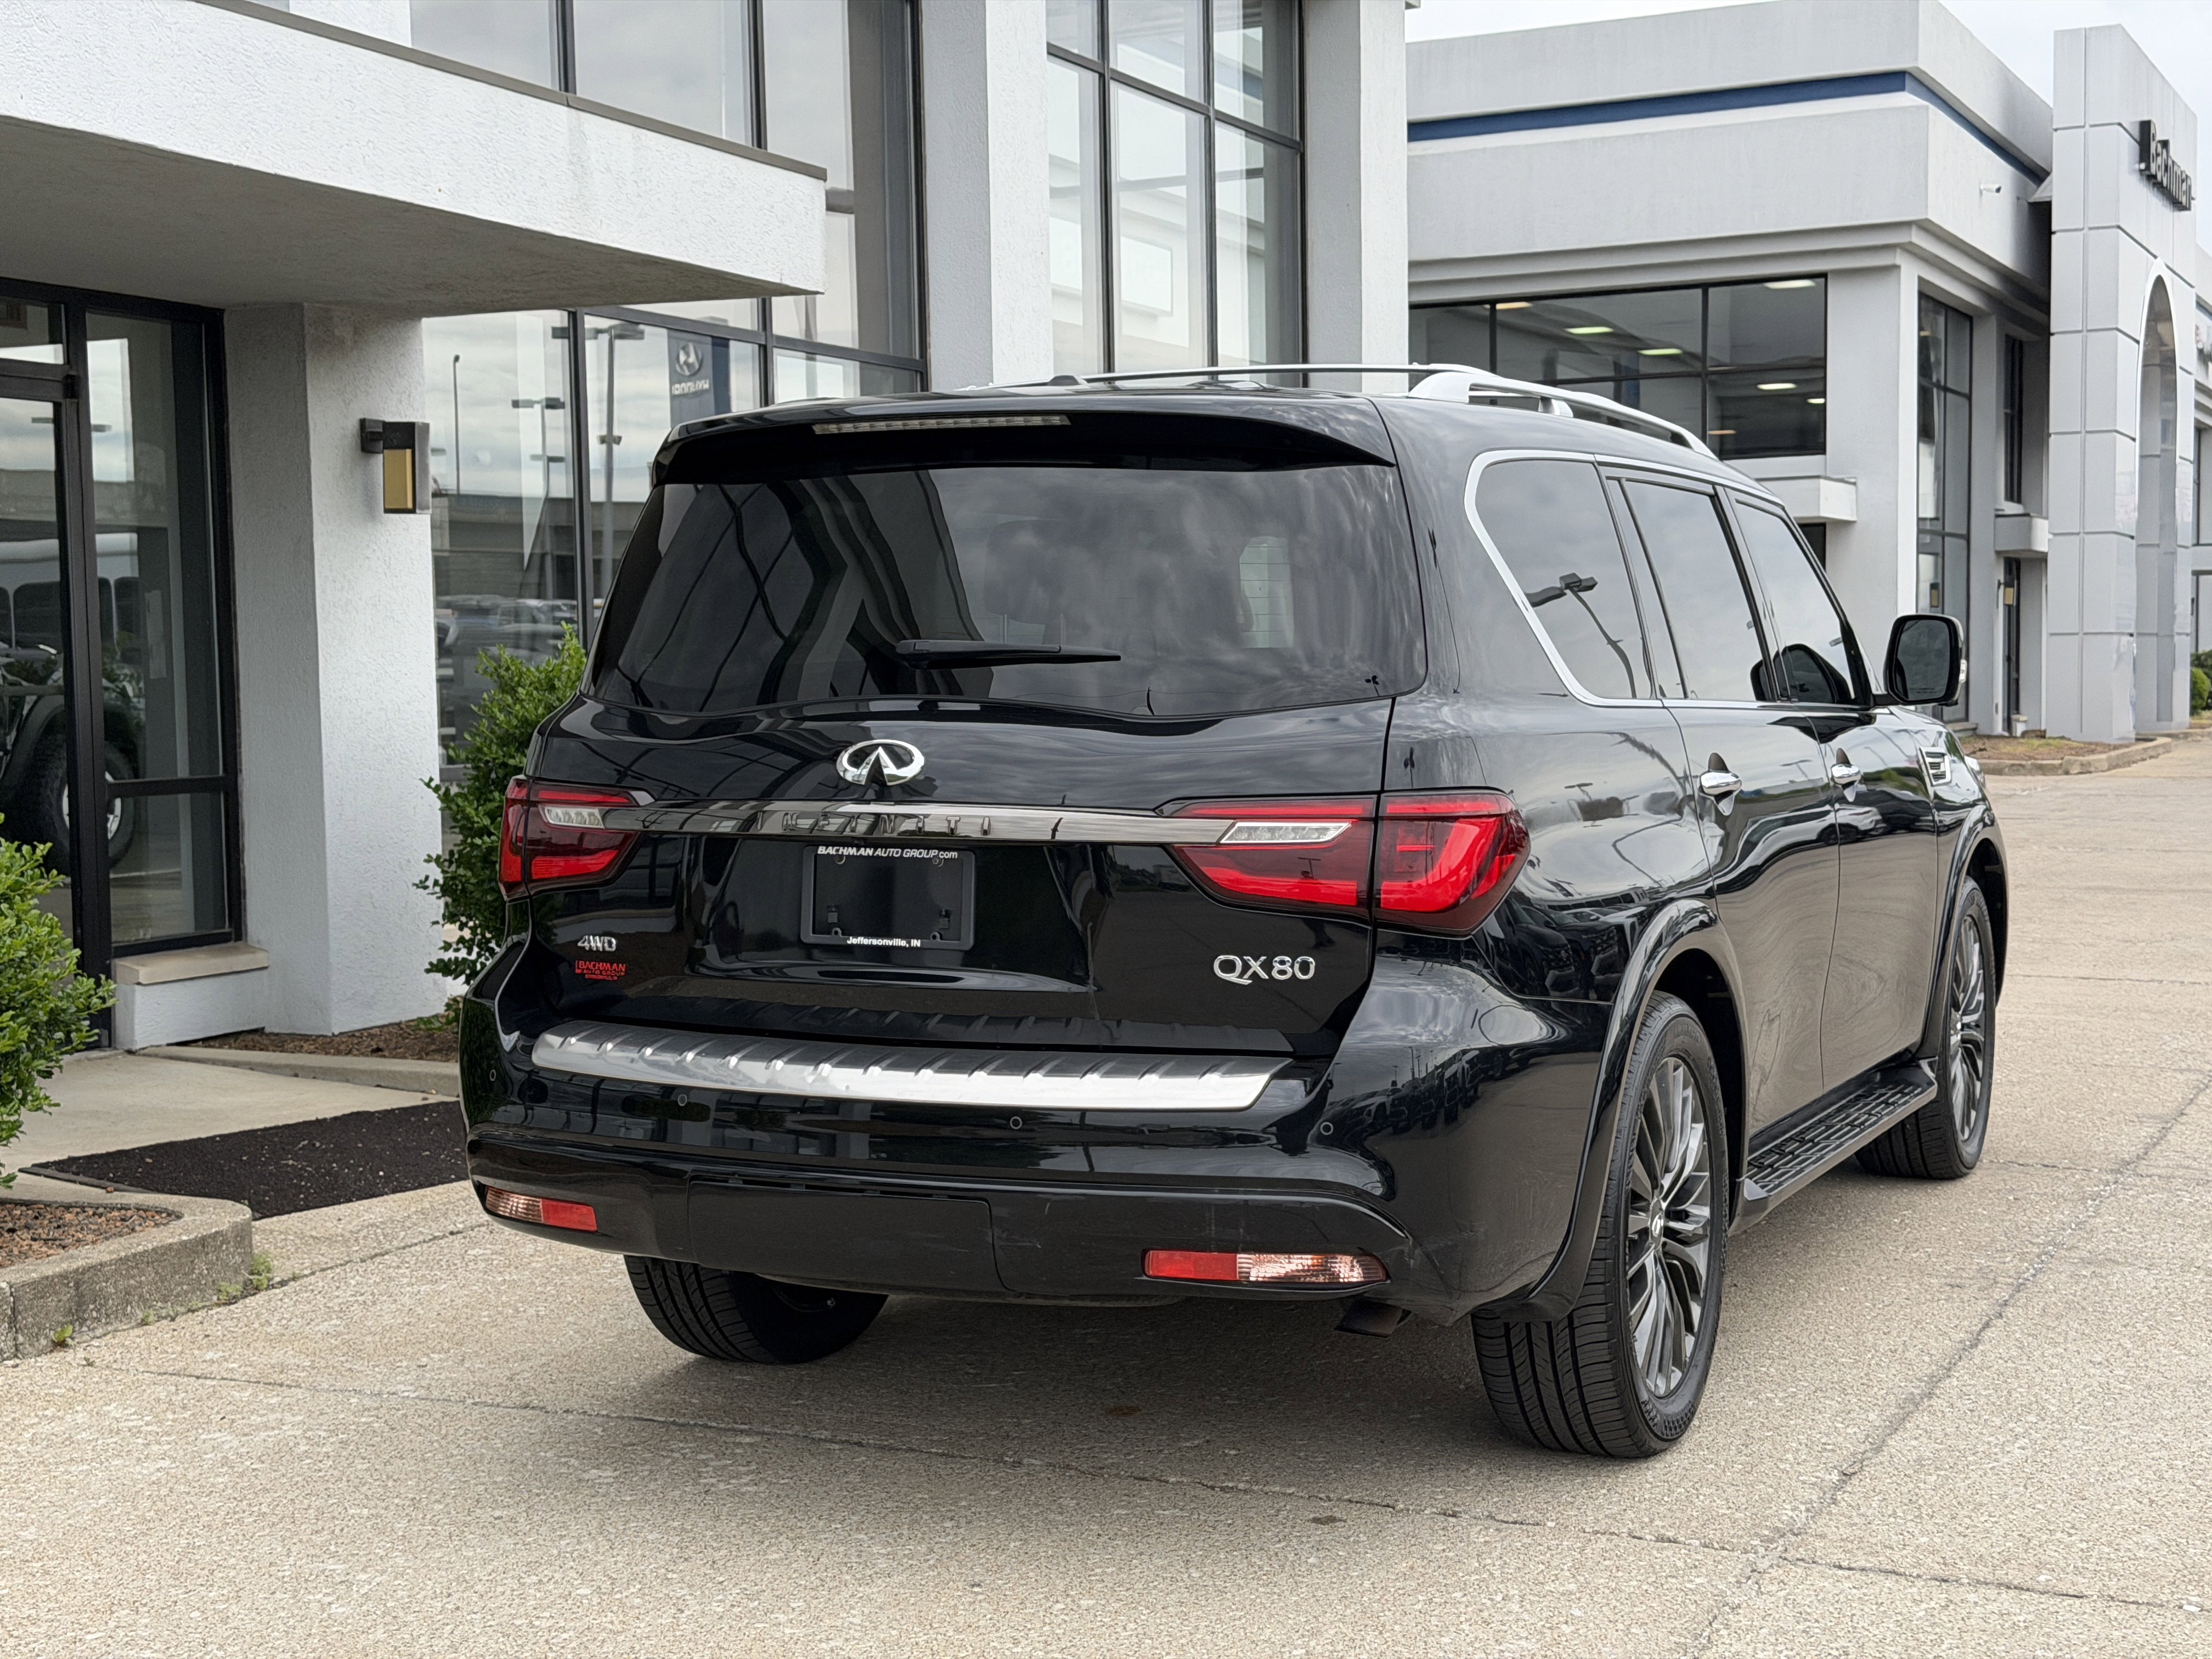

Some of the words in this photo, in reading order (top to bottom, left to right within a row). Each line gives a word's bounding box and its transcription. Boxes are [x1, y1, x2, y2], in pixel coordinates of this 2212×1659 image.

[817, 846, 873, 856] BACHMAN
[874, 848, 901, 857] AUTO
[577, 935, 617, 952] 4WD
[847, 936, 909, 948] Jeffersonville,
[911, 939, 921, 947] IN
[579, 960, 626, 972] BACHMAN
[1213, 955, 1316, 985] QX80
